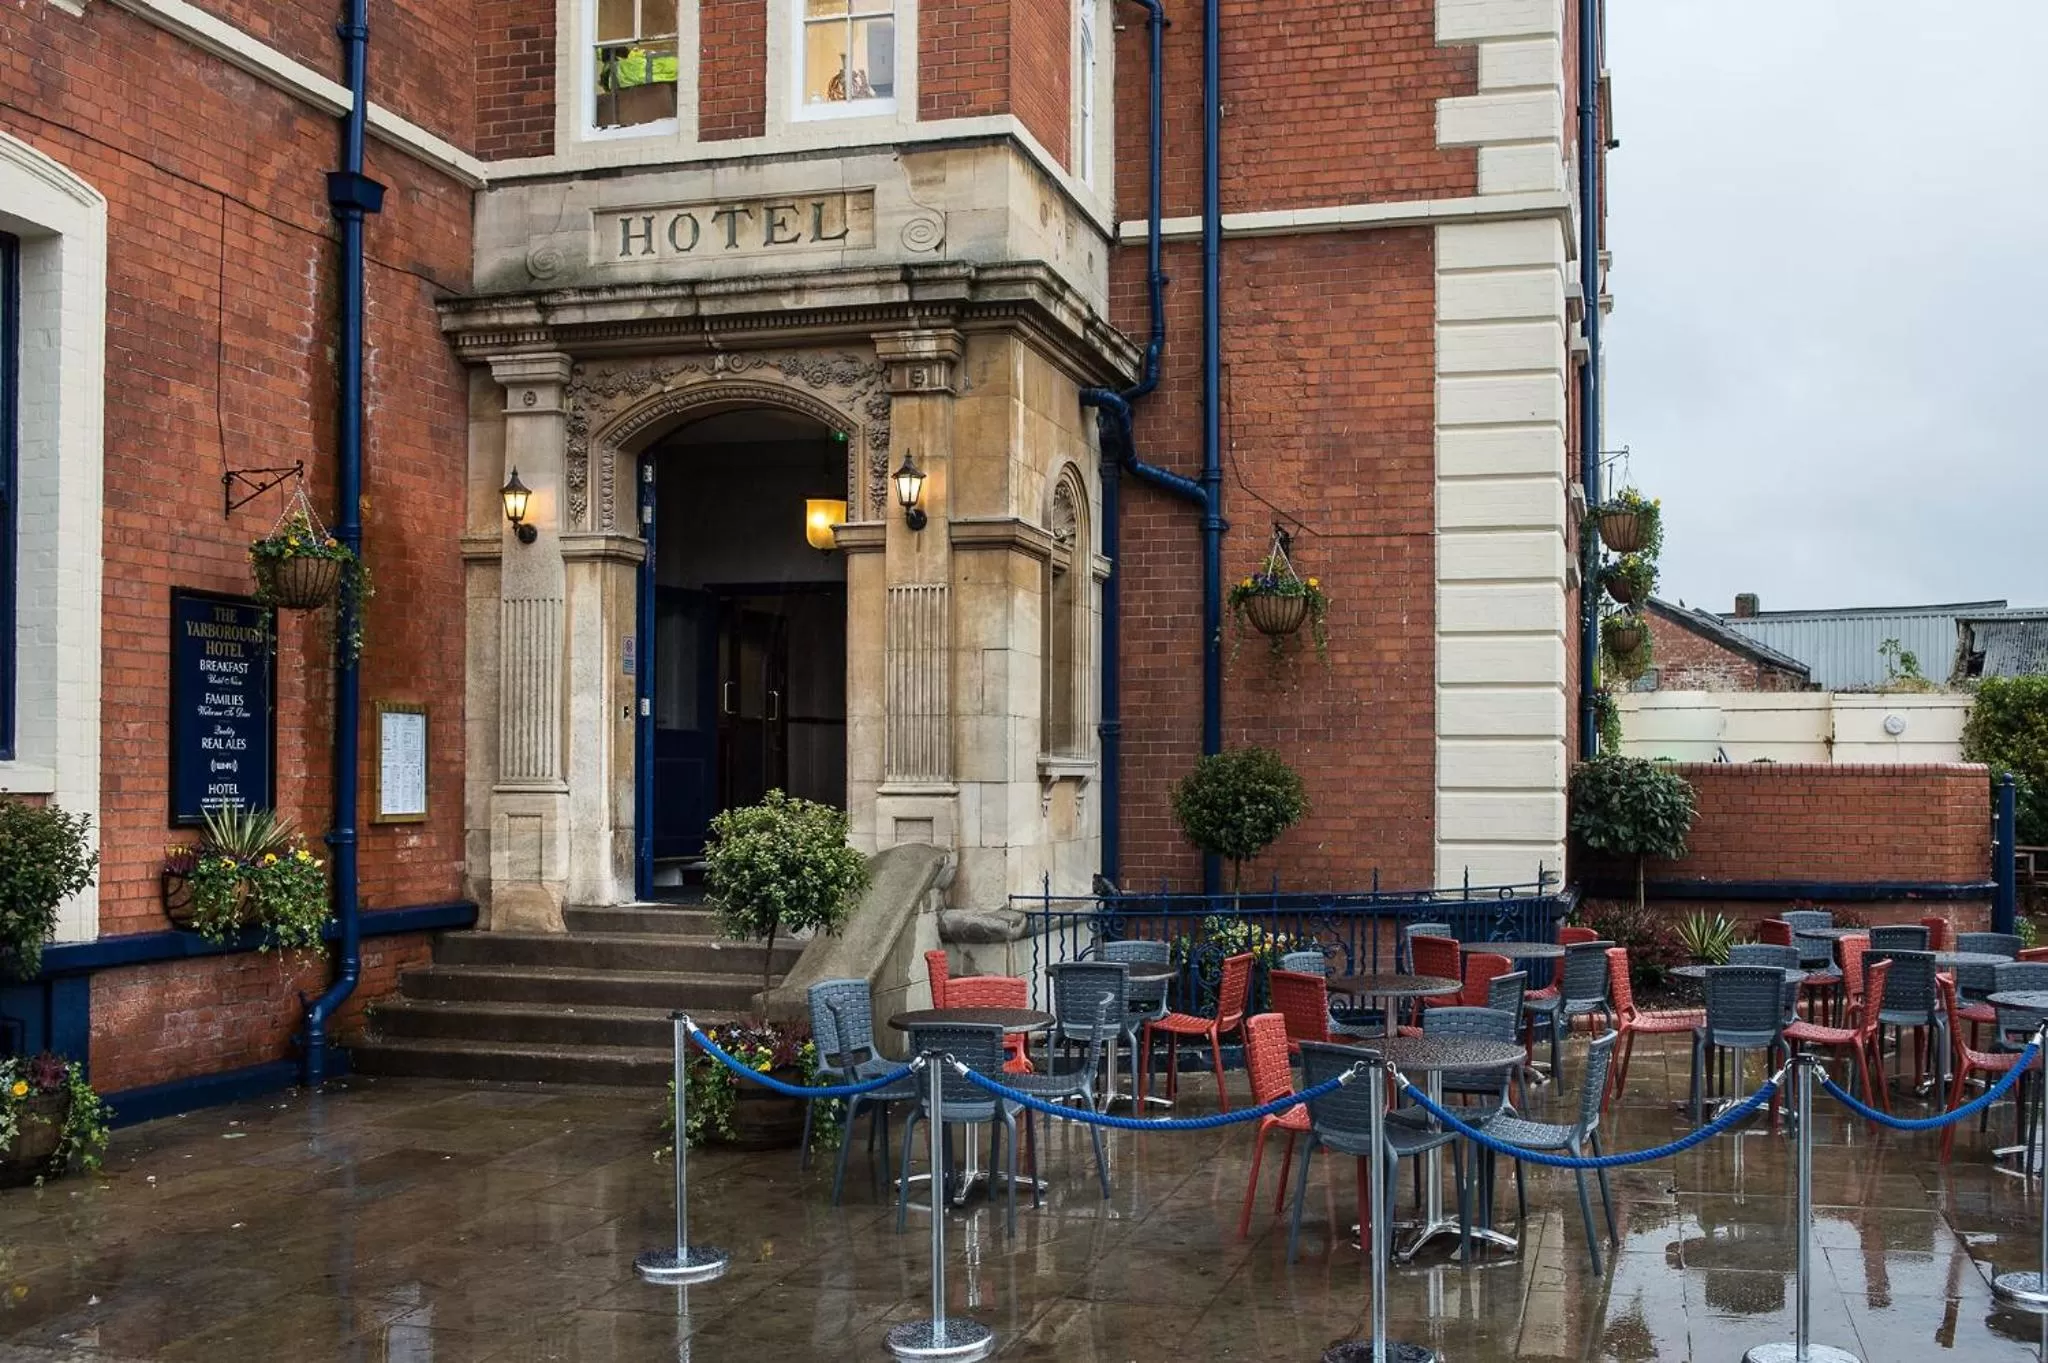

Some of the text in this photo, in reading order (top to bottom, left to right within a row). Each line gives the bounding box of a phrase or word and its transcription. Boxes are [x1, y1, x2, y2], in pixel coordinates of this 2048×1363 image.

[619, 202, 850, 257] HOTEL
[213, 607, 238, 623] THE
[186, 620, 263, 643] YARBOROUGH
[205, 640, 244, 657] HOTEL
[199, 659, 249, 674] BREAKFAST
[205, 692, 244, 706] FAMILIES
[201, 737, 247, 750] REAL ALES
[208, 783, 239, 795] HOTEL
